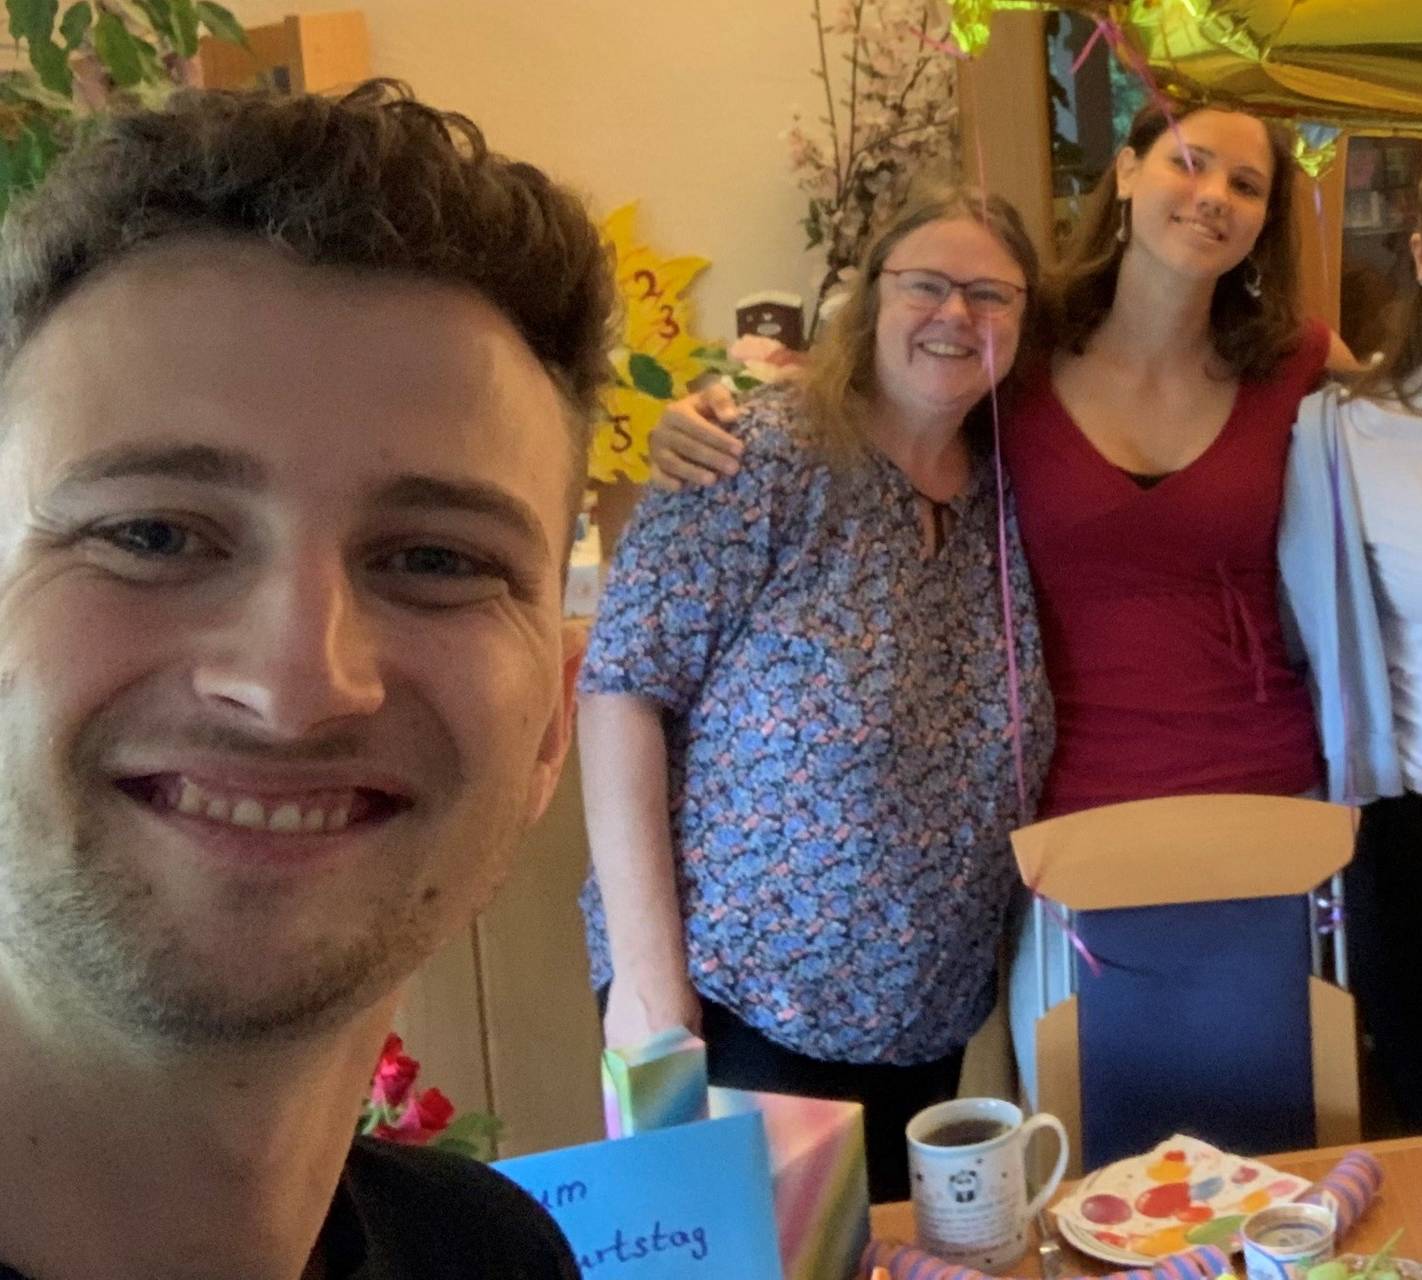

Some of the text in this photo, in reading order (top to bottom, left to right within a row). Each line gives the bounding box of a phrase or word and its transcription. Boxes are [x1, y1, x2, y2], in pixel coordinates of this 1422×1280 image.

[634, 270, 663, 299] 2
[659, 305, 680, 338] 3
[610, 415, 632, 453] 5
[540, 1180, 587, 1208] um
[578, 1221, 708, 1269] urtstag
